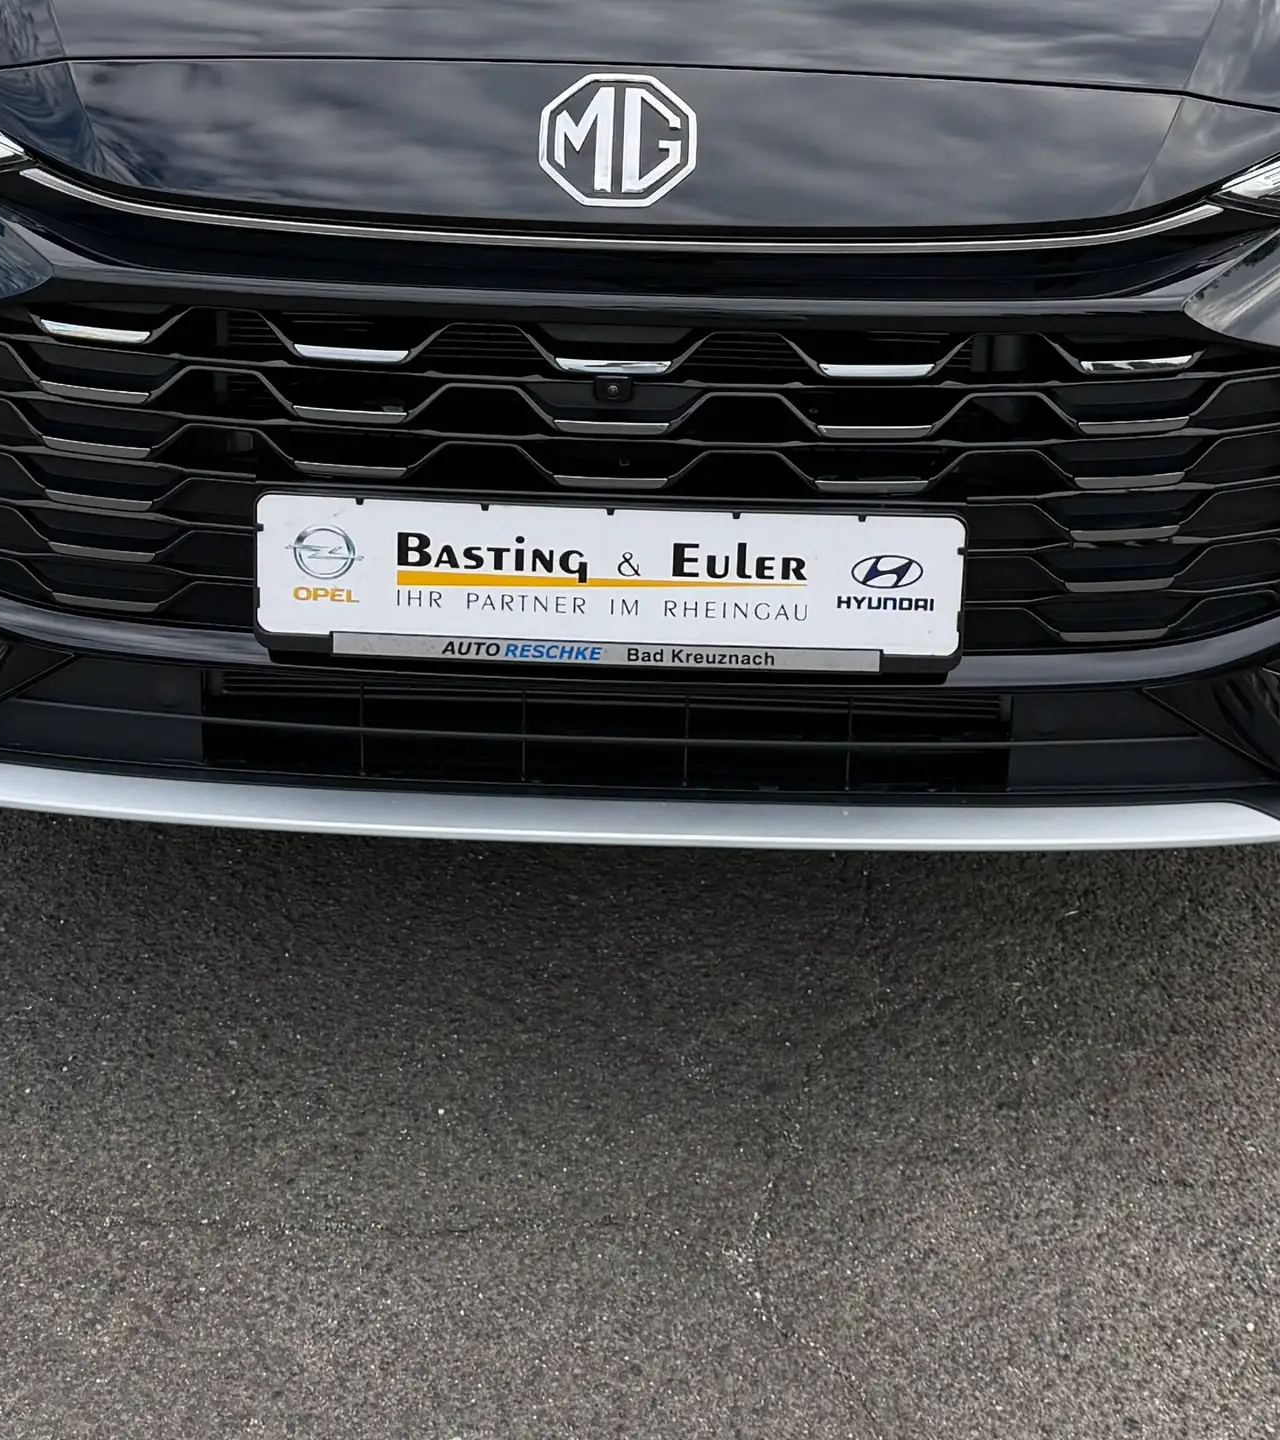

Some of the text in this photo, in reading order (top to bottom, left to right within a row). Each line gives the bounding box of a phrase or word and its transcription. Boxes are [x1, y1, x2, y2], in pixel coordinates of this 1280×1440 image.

[554, 86, 682, 194] MG
[617, 551, 642, 577] &
[292, 585, 360, 603] OPEL
[396, 589, 809, 621] IHR PARTNER IM RHEINGAU
[836, 595, 935, 611] HYUNDAI
[441, 641, 775, 667] AUTO RESCHKE Bad Kreuznach
